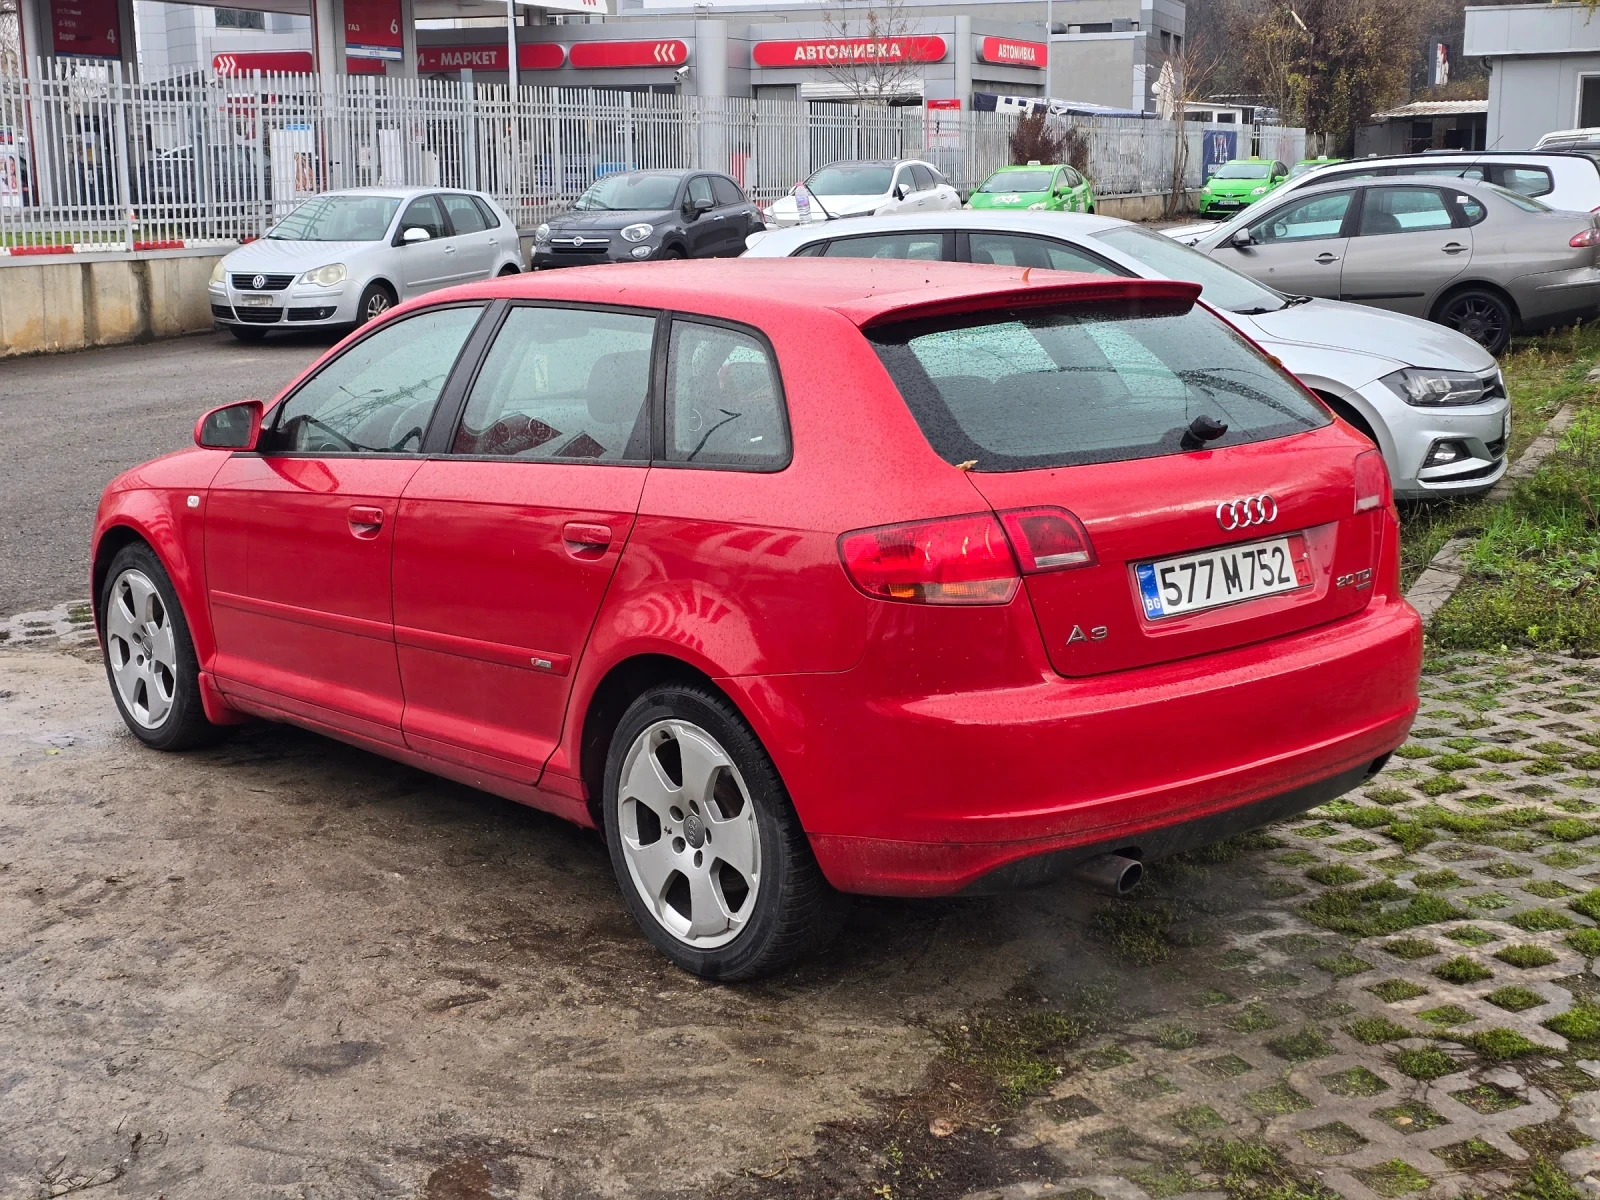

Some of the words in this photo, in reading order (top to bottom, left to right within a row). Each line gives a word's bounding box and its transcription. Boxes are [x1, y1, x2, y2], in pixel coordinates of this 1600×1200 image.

[348, 23, 360, 31] ГАЗ
[390, 18, 398, 34] 6
[106, 28, 116, 43] 4
[440, 51, 497, 66] МАРКЕТ
[794, 42, 902, 60] АВТОМИВКА
[998, 44, 1036, 61] АВТОМИВКА
[1147, 598, 1161, 611] BG
[1066, 624, 1107, 646] A3
